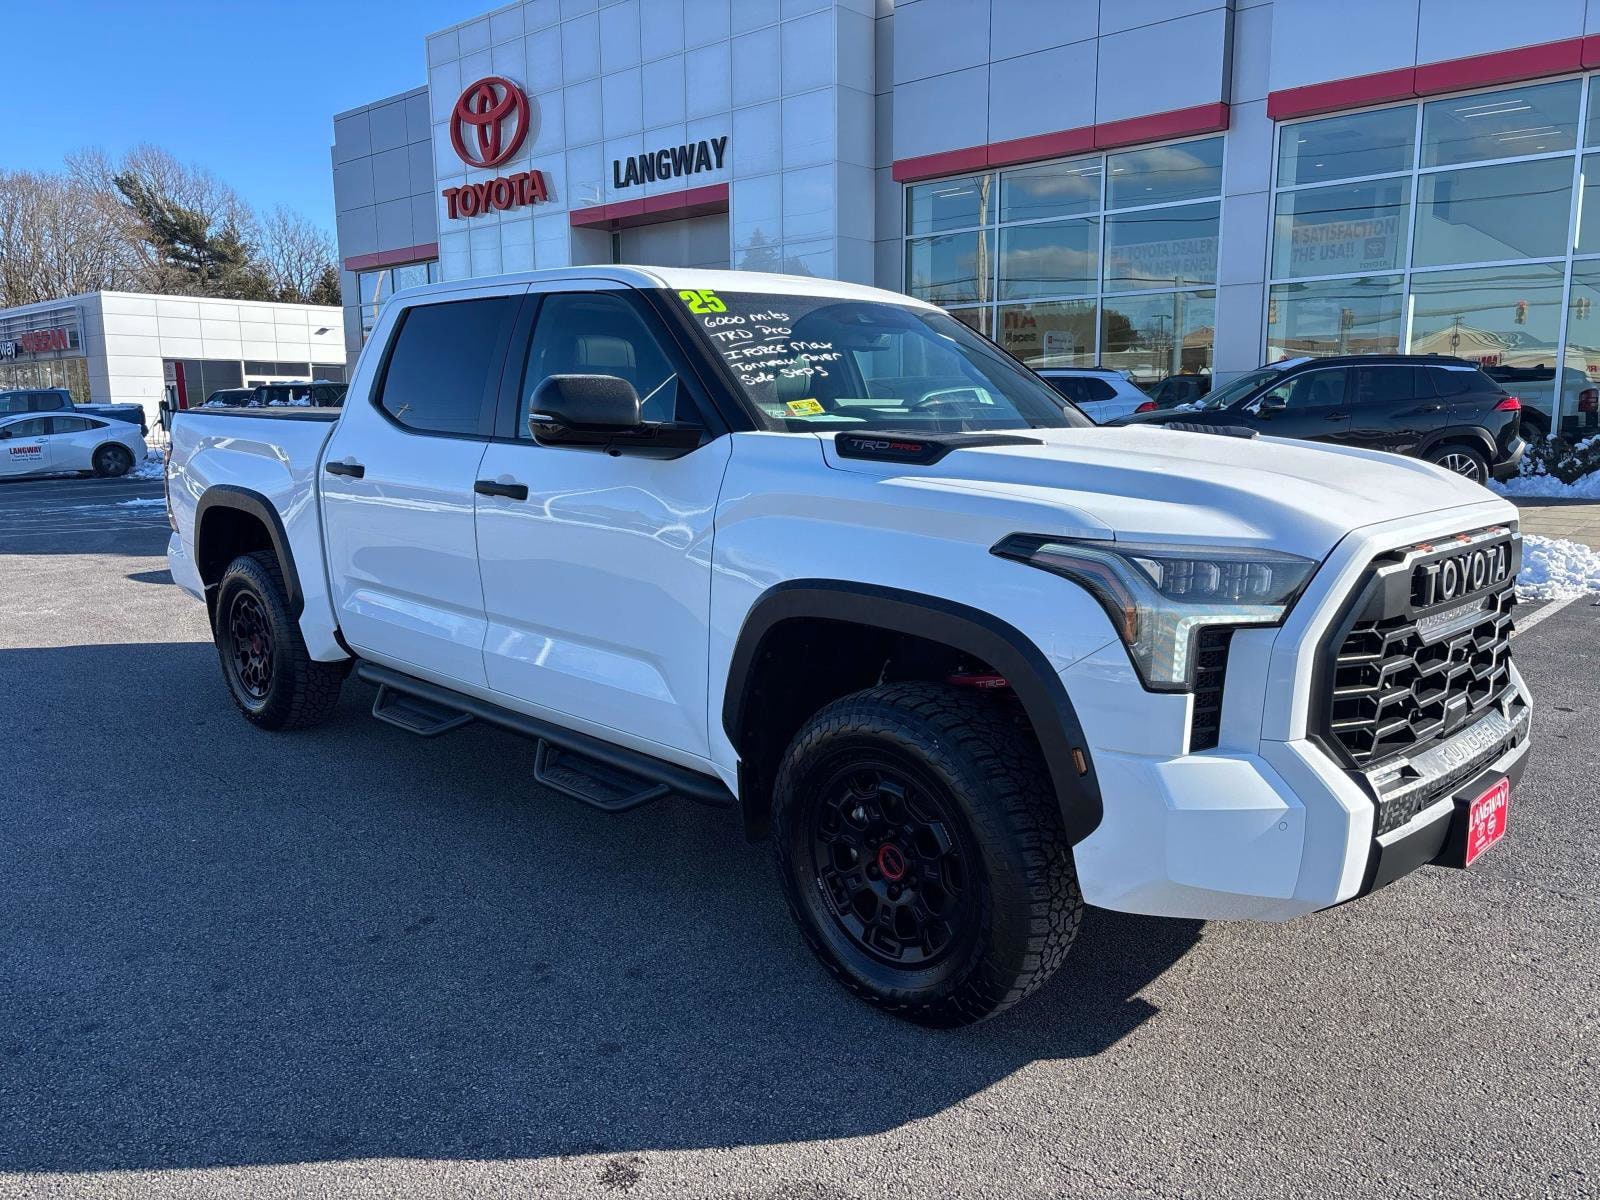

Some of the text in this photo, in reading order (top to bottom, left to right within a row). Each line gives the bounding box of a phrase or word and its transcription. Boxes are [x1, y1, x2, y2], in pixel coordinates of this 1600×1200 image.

[613, 136, 728, 189] LANGWAY
[441, 169, 549, 220] TOYOTA
[1302, 217, 1397, 244] SATISFACTION
[1127, 243, 1169, 261] TOYOTA
[1172, 239, 1214, 256] DEALER
[1292, 246, 1317, 264] THE
[678, 289, 728, 315] 25
[704, 316, 746, 328] 6000
[22, 326, 70, 353] NISSAN
[710, 330, 753, 342] TRD
[740, 373, 776, 386] Side
[9, 446, 42, 455] LANGWAY
[851, 439, 922, 452] TRD PRO
[1425, 545, 1506, 605] TOYOTA
[975, 679, 1006, 688] TRD
[1436, 722, 1498, 768] TUNDRA
[1469, 788, 1508, 832] LANGWAY
